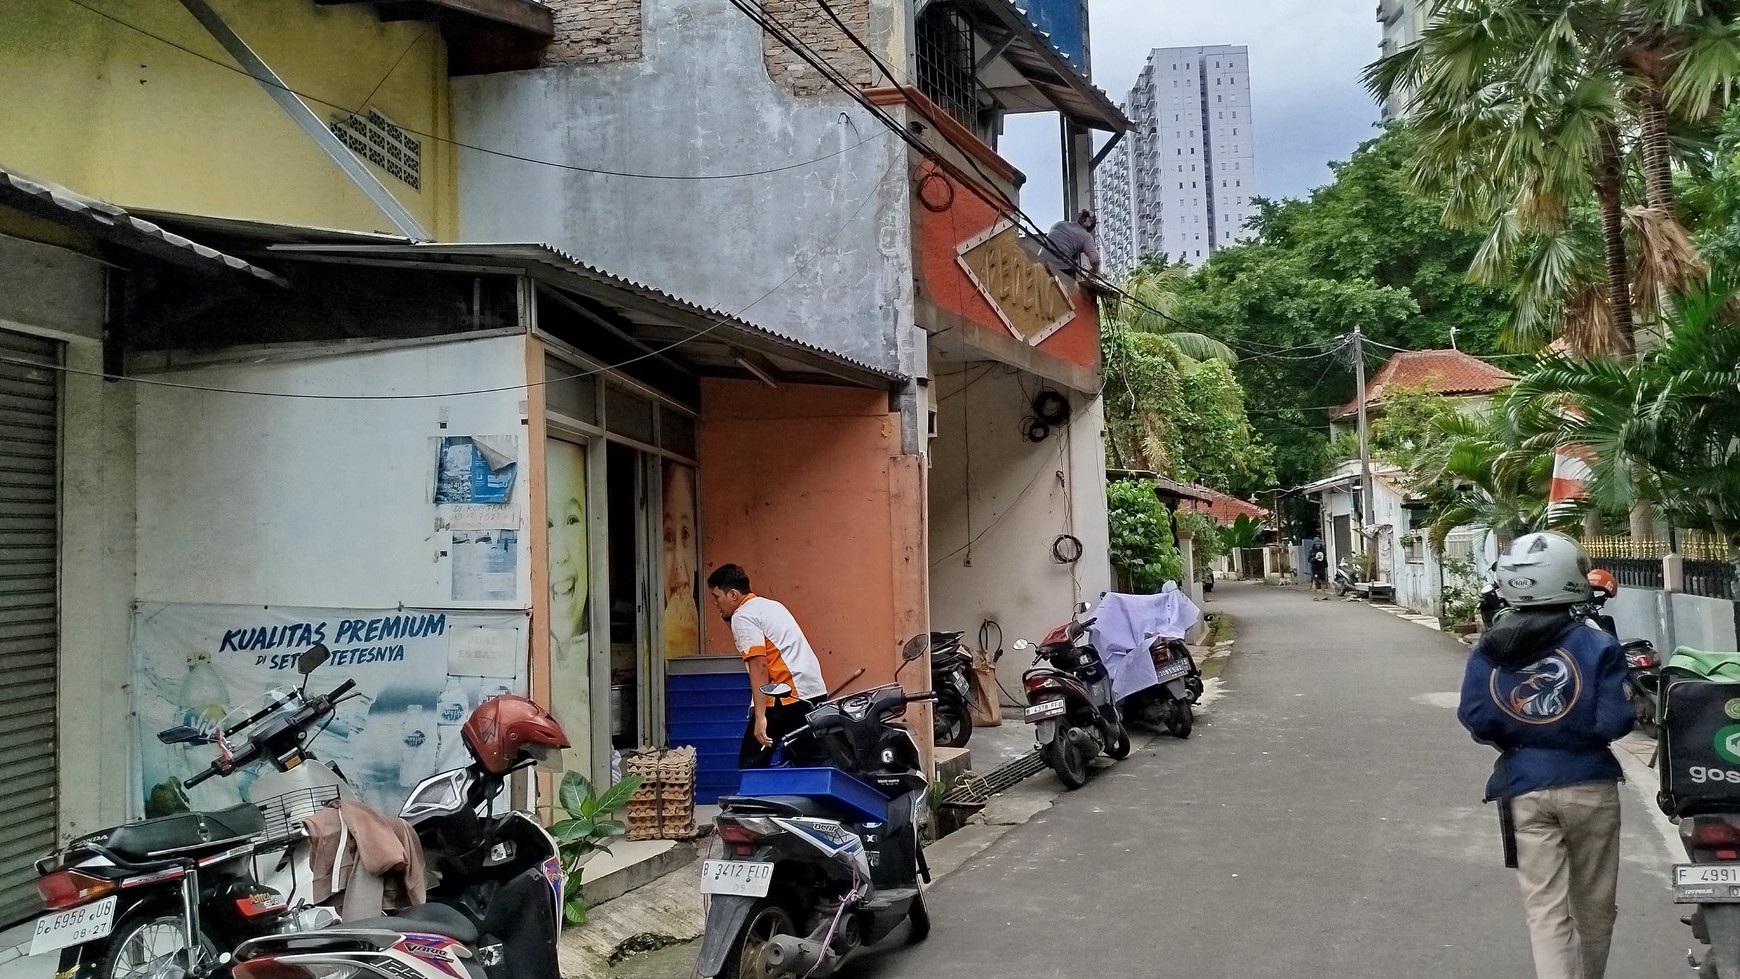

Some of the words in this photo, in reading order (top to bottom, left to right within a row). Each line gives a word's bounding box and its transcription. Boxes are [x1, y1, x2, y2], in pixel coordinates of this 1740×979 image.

[218, 621, 328, 653] KUALITAS
[334, 613, 447, 644] PREMIUM
[467, 636, 498, 644] JUAL
[255, 655, 267, 666] DI
[269, 652, 301, 670] SET
[329, 644, 405, 666] TETESNYA
[458, 650, 472, 658] ES
[703, 862, 710, 877] B
[715, 863, 742, 877] 3412
[1679, 869, 1687, 881] F
[1700, 869, 1737, 881] 4991
[36, 919, 46, 936] B
[53, 908, 86, 930] 6958
